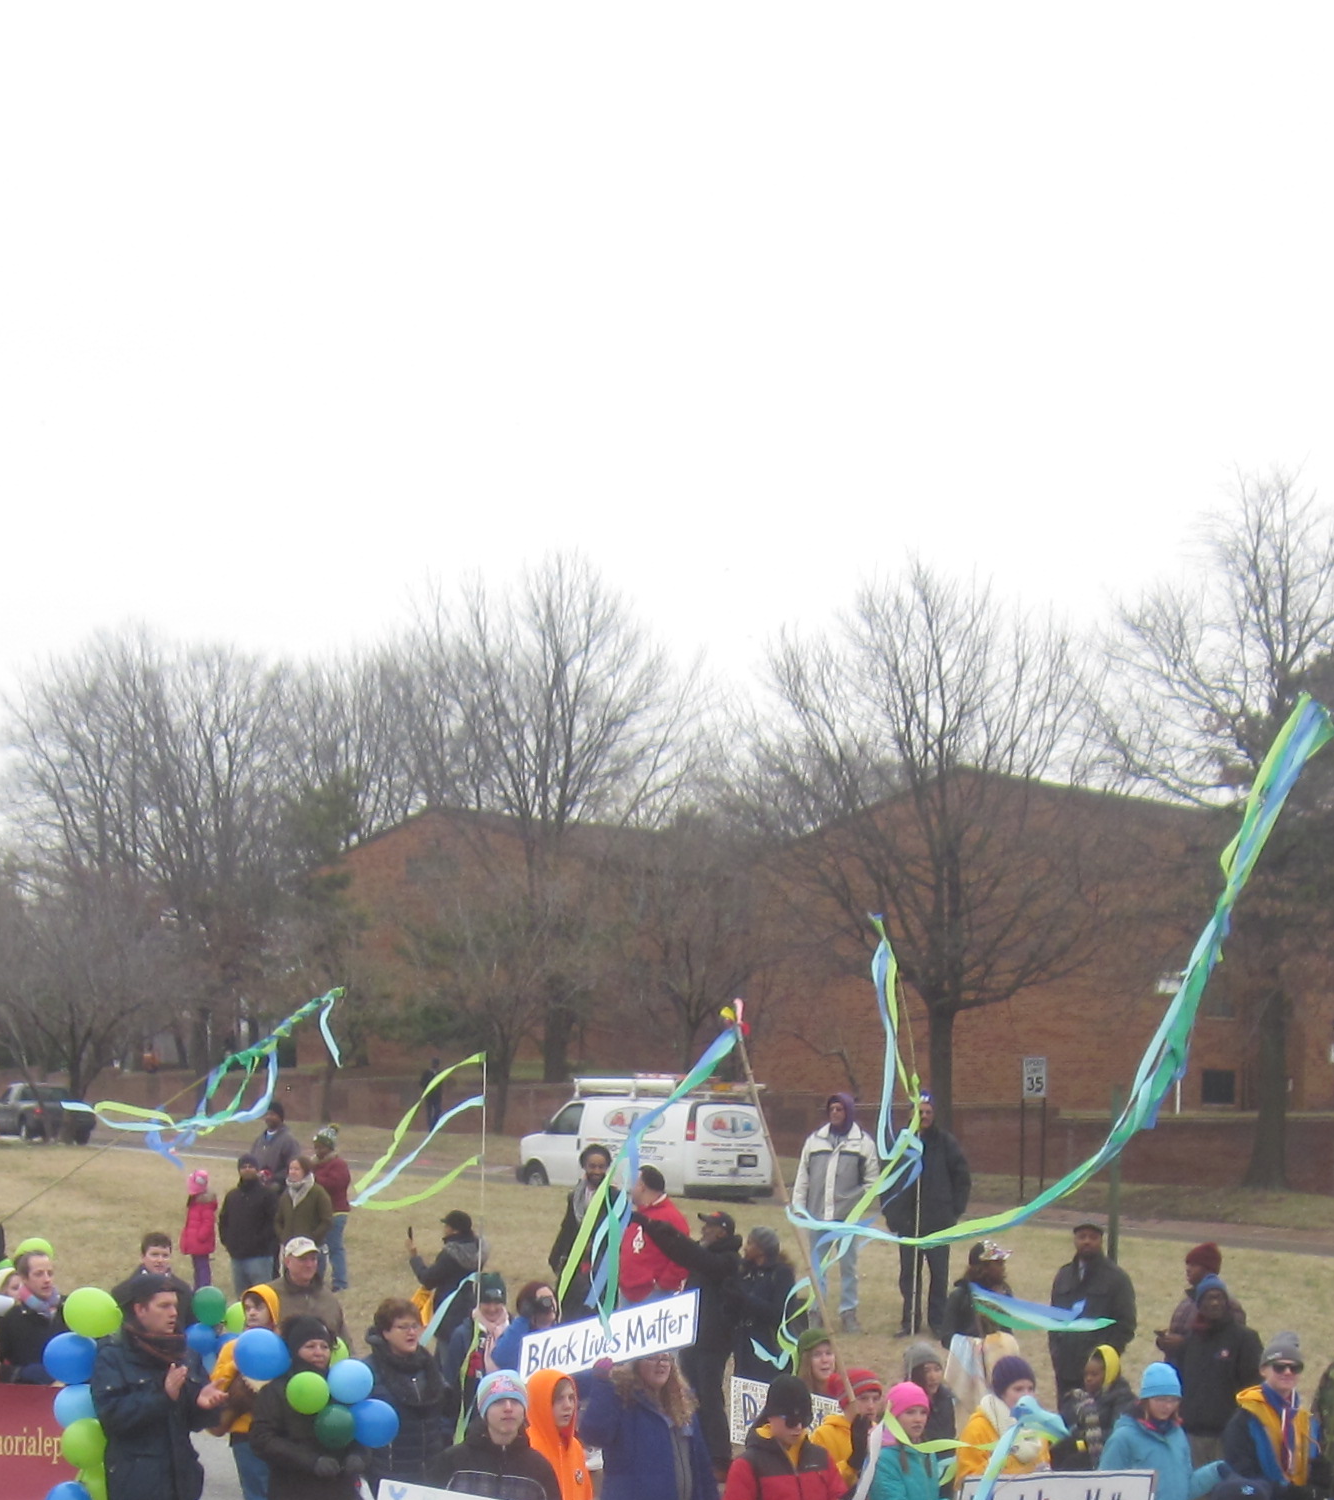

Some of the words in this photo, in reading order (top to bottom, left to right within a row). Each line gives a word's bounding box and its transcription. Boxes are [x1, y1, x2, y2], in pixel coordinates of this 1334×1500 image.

[1026, 1076, 1044, 1093] 35
[525, 1332, 578, 1377] Black
[580, 1328, 621, 1365] Lives
[625, 1308, 689, 1354] Matter
